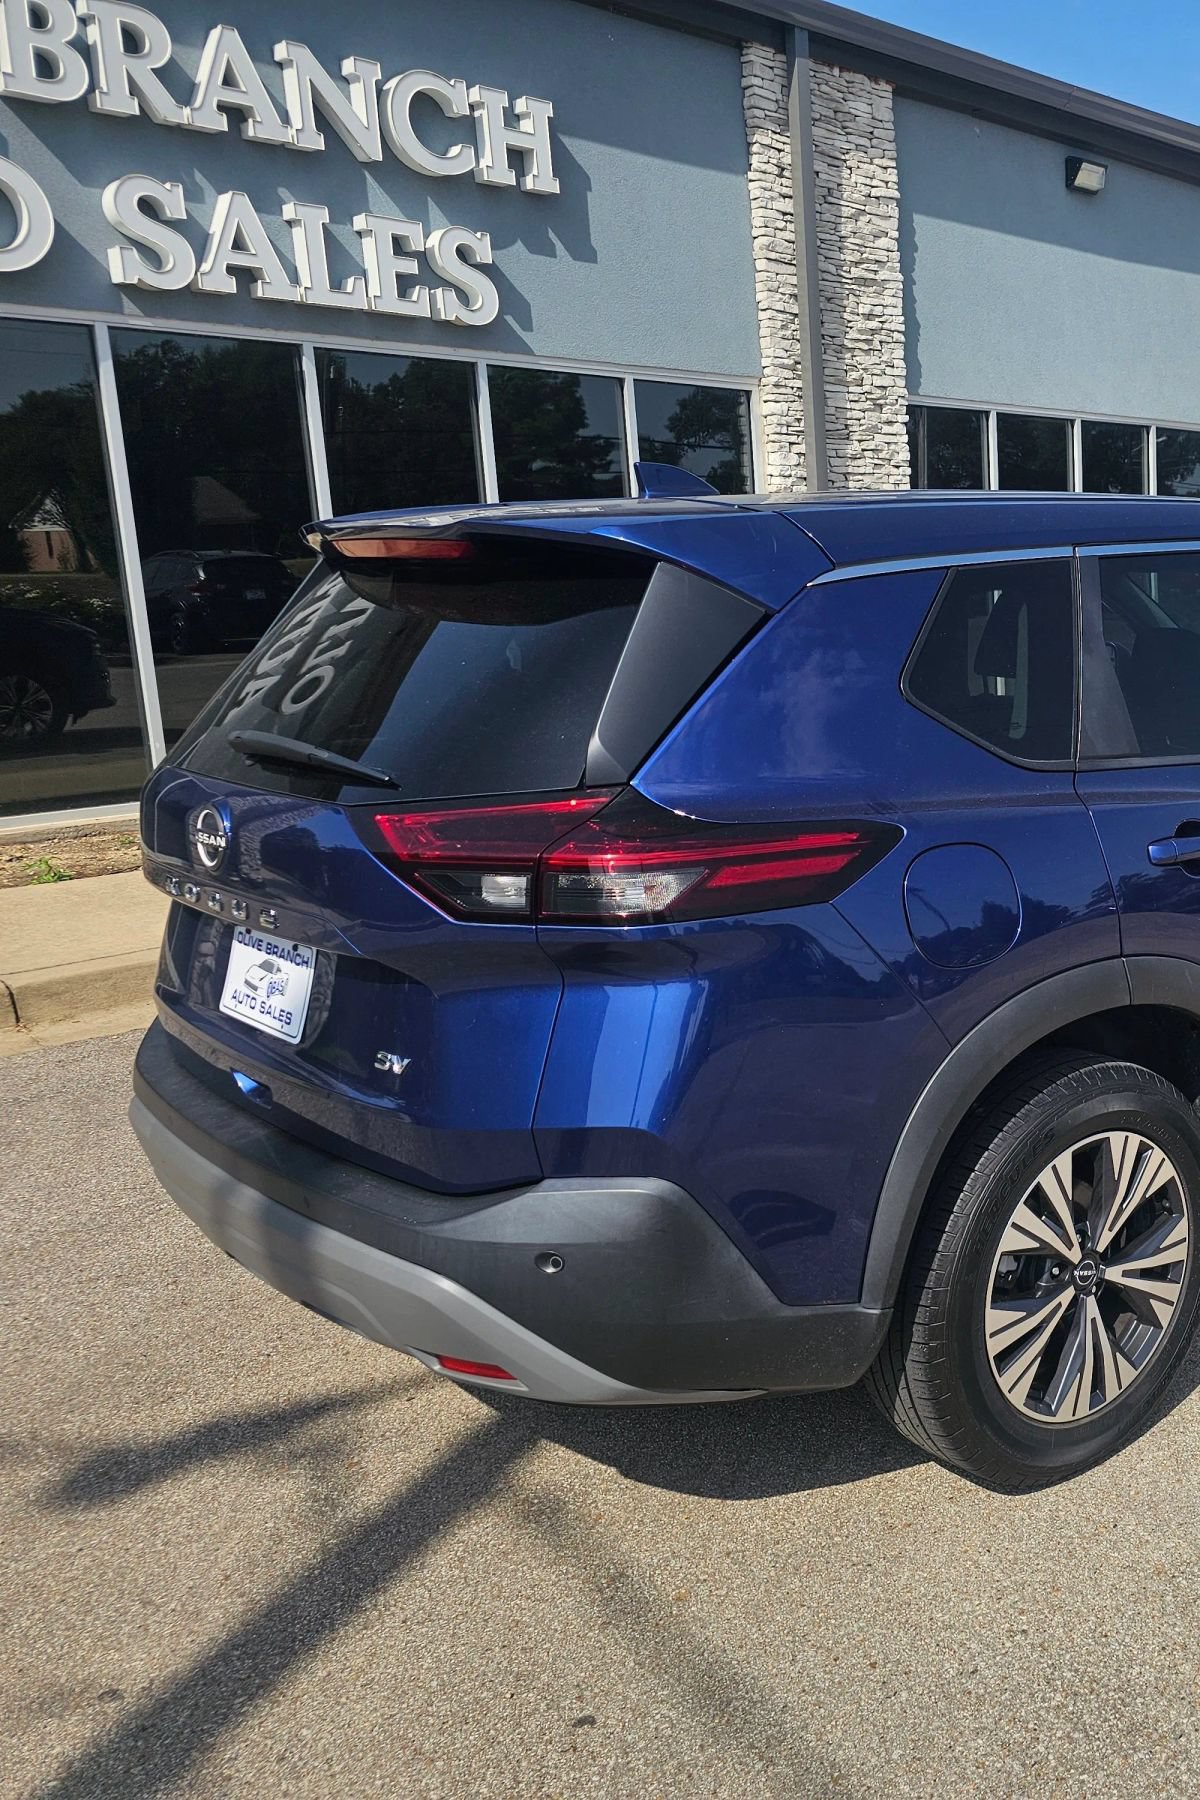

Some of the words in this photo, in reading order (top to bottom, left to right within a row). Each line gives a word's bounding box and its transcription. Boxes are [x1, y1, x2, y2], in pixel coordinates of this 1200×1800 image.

[0, 0, 560, 195] BRANCH
[102, 174, 499, 326] SALES
[237, 931, 264, 953] OLIVE
[265, 942, 310, 970] BRANCH
[231, 988, 257, 1010] AUTO
[260, 1001, 293, 1026] SALES
[374, 1050, 412, 1075] SV
